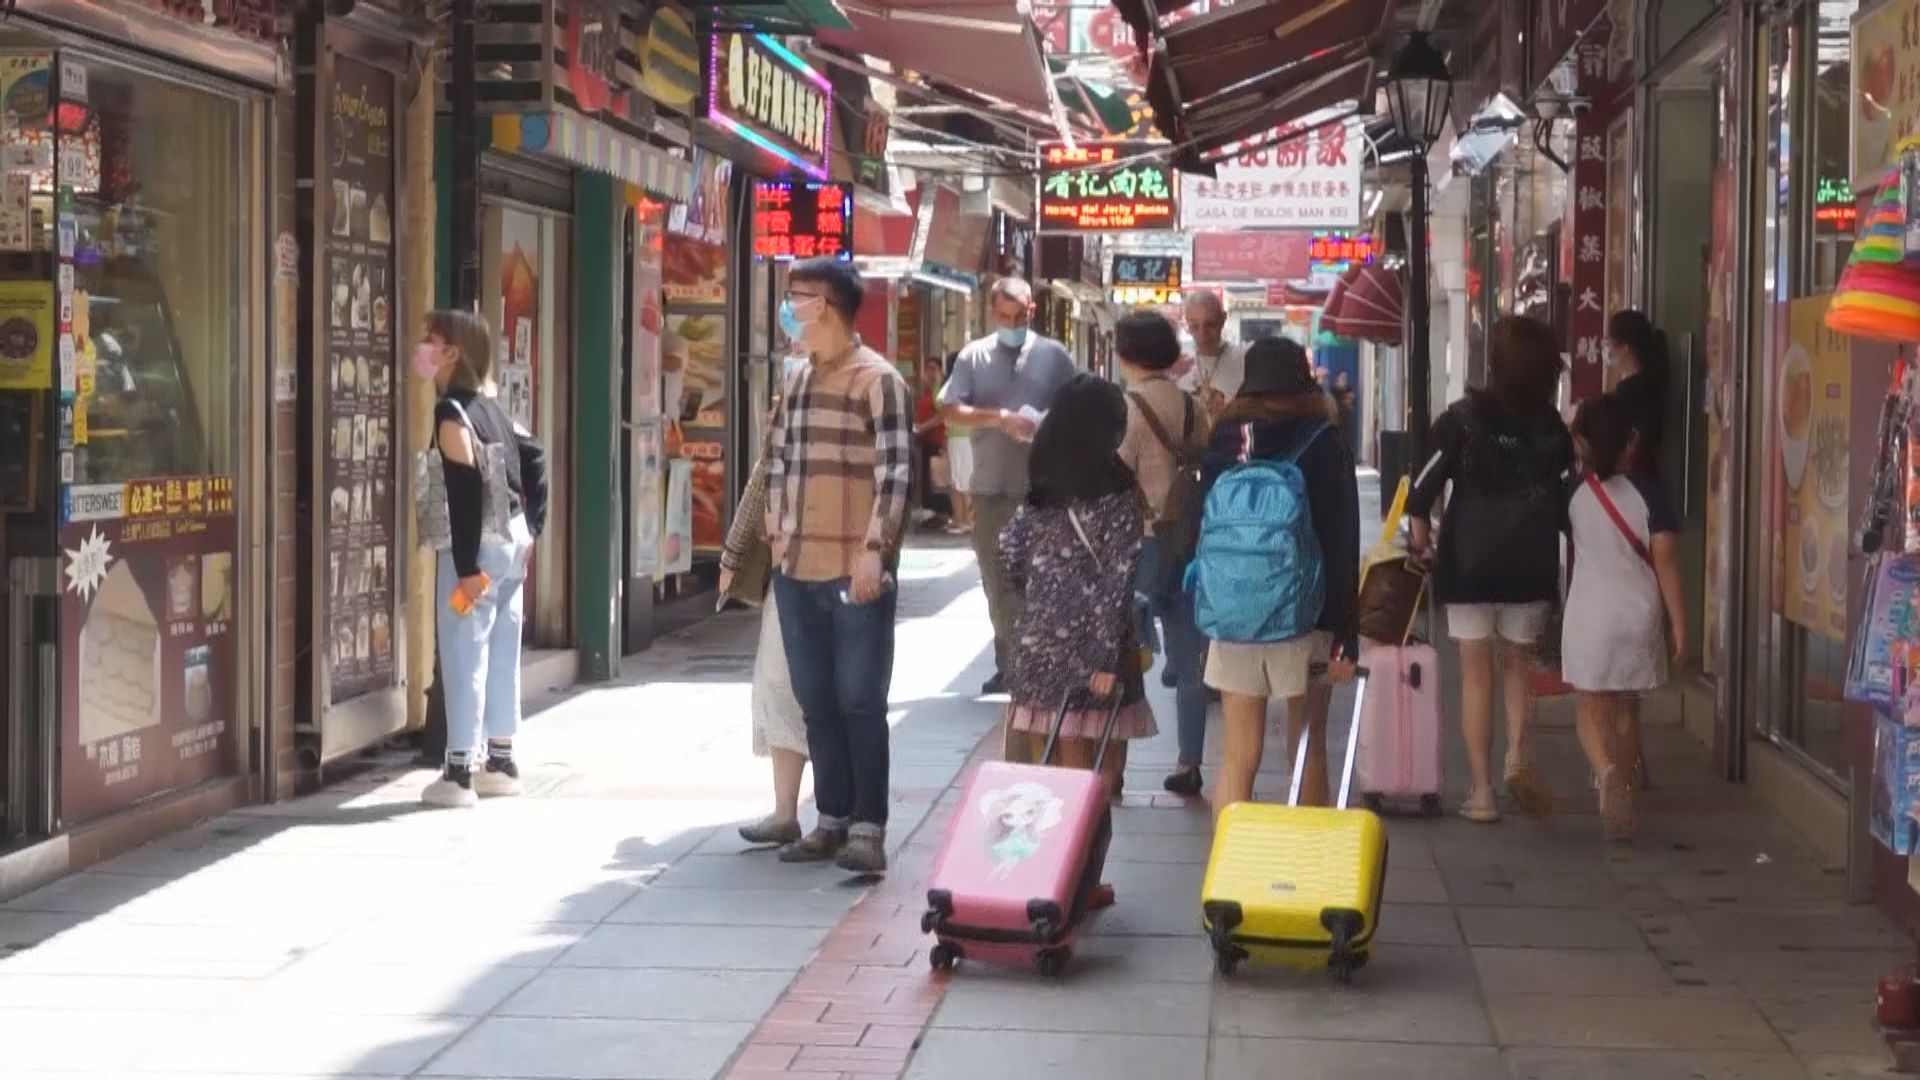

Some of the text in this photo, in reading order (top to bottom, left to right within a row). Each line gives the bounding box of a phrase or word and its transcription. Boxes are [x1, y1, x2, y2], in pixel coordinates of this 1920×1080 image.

[1207, 120, 1348, 168] 記餅家
[1196, 207, 1227, 219] CASA
[1233, 207, 1248, 218] DE
[1254, 206, 1293, 218] BOLOS
[1299, 206, 1324, 218] MAN
